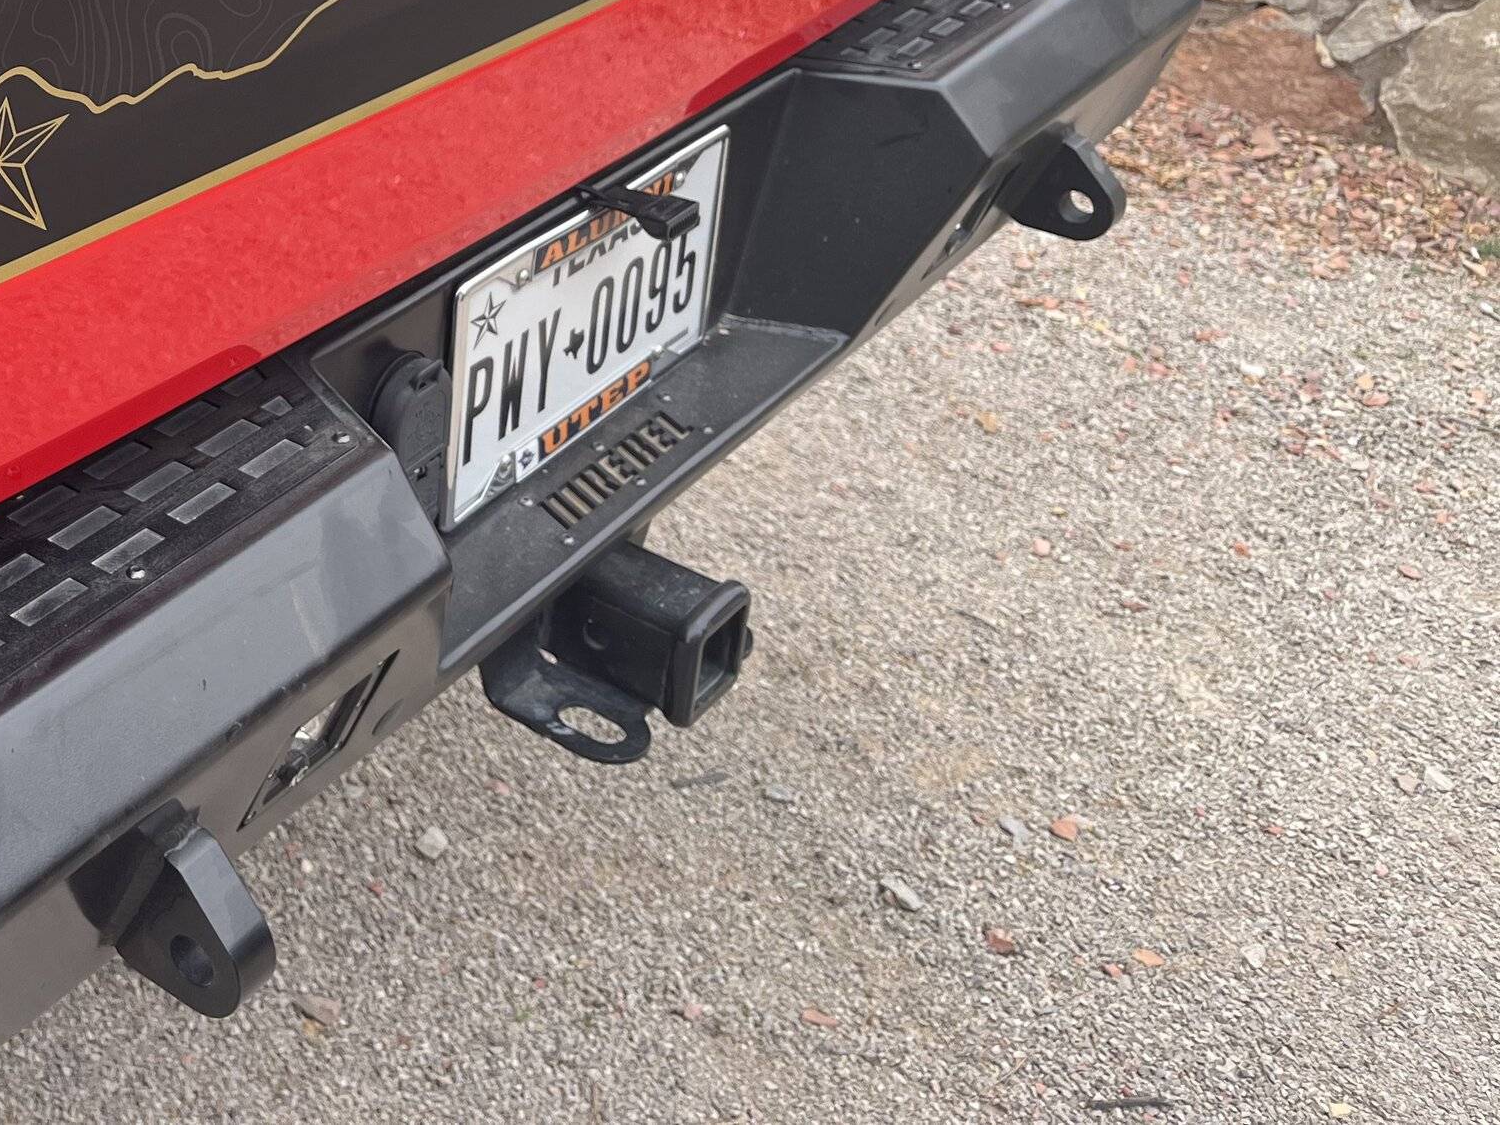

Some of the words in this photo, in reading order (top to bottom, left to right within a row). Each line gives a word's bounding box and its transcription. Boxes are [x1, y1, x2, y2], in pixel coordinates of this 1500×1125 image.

[462, 307, 561, 467] PWY
[586, 232, 697, 375] 0095
[541, 361, 651, 455] UTEP
